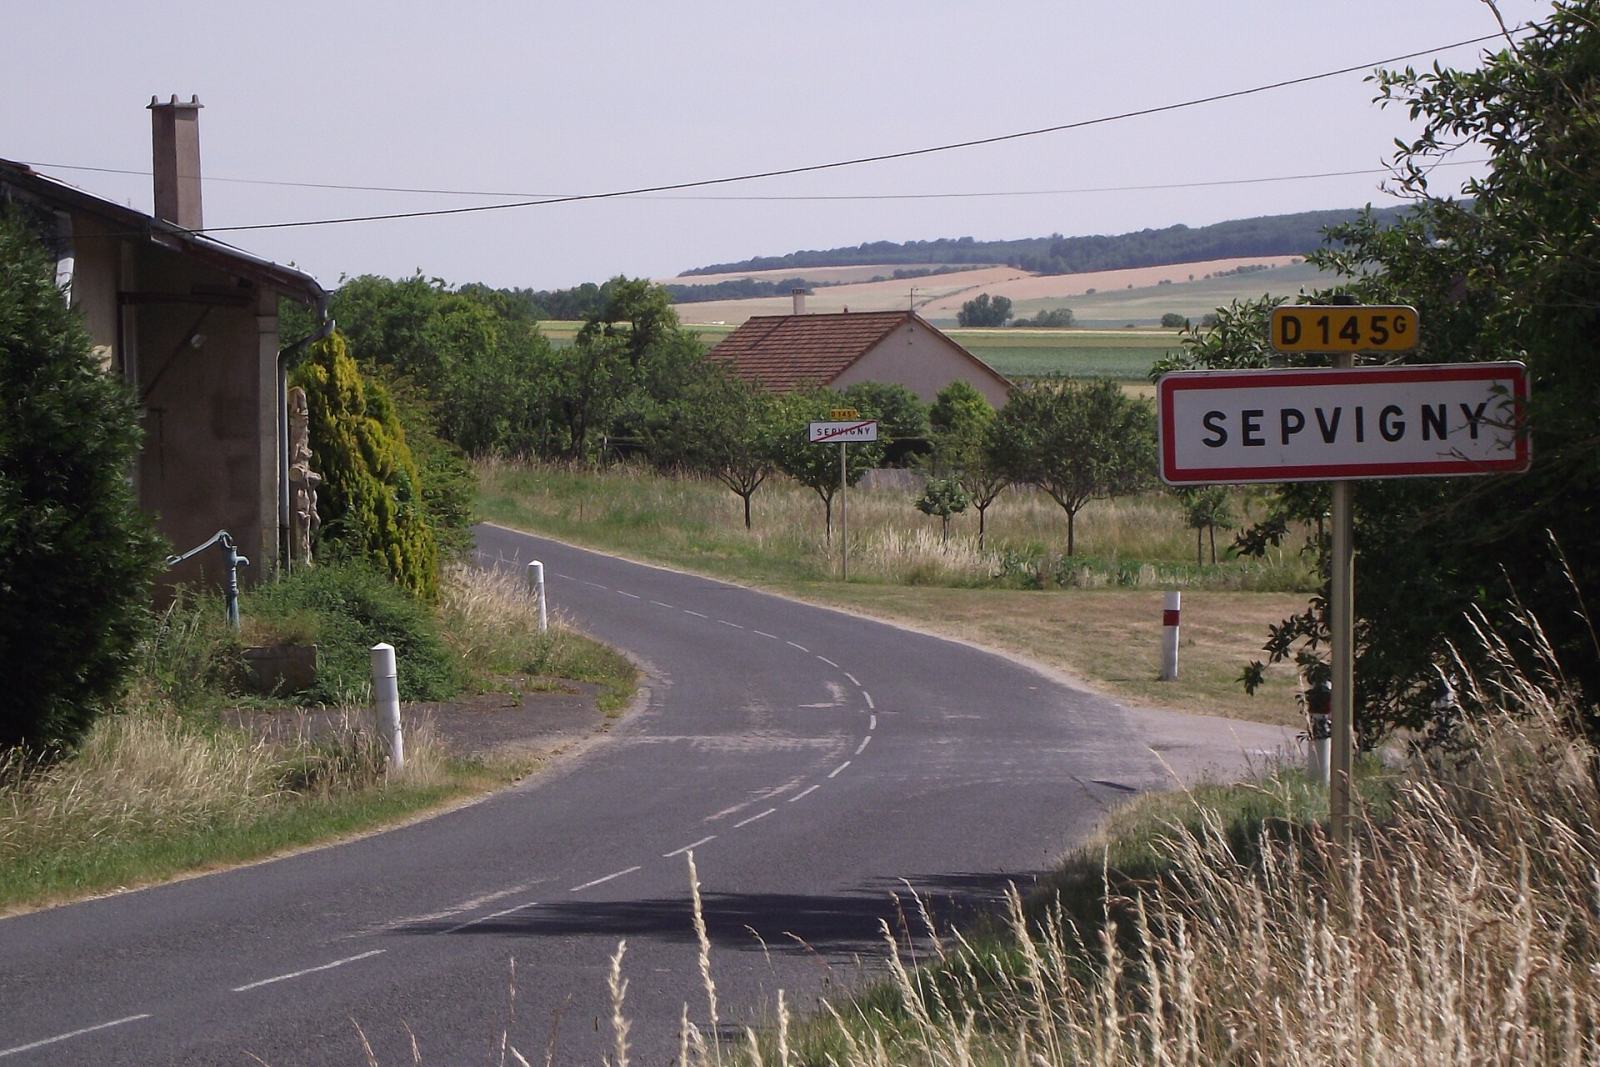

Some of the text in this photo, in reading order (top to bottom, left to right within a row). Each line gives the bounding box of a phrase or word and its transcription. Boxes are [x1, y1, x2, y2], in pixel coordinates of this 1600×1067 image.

[1281, 315, 1302, 345] D
[816, 427, 870, 436] SEPVIGNY
[1201, 402, 1488, 448] SEPVIGNY
